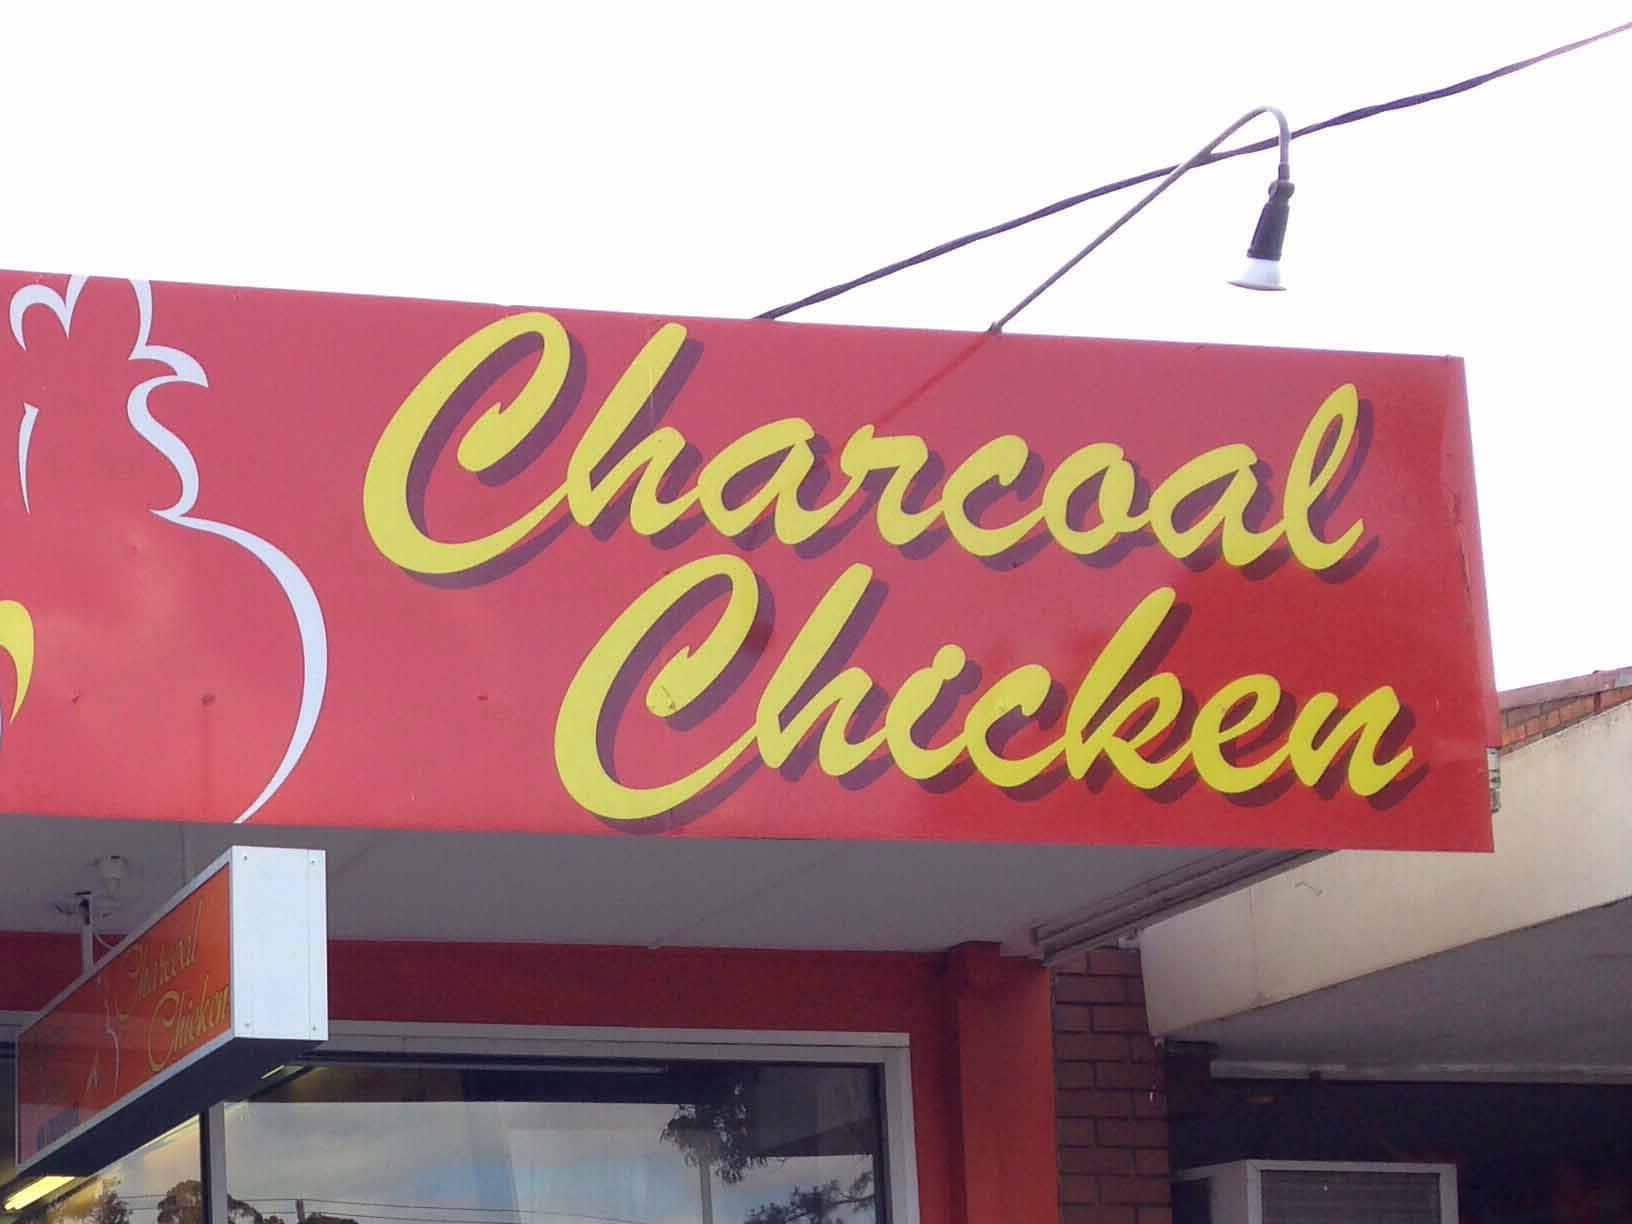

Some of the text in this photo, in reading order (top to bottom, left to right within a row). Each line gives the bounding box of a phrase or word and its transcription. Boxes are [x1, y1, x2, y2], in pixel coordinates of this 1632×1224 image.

[363, 311, 1365, 577] Charcoal
[554, 553, 1415, 822] Chicken
[147, 974, 230, 1073] Chicken
